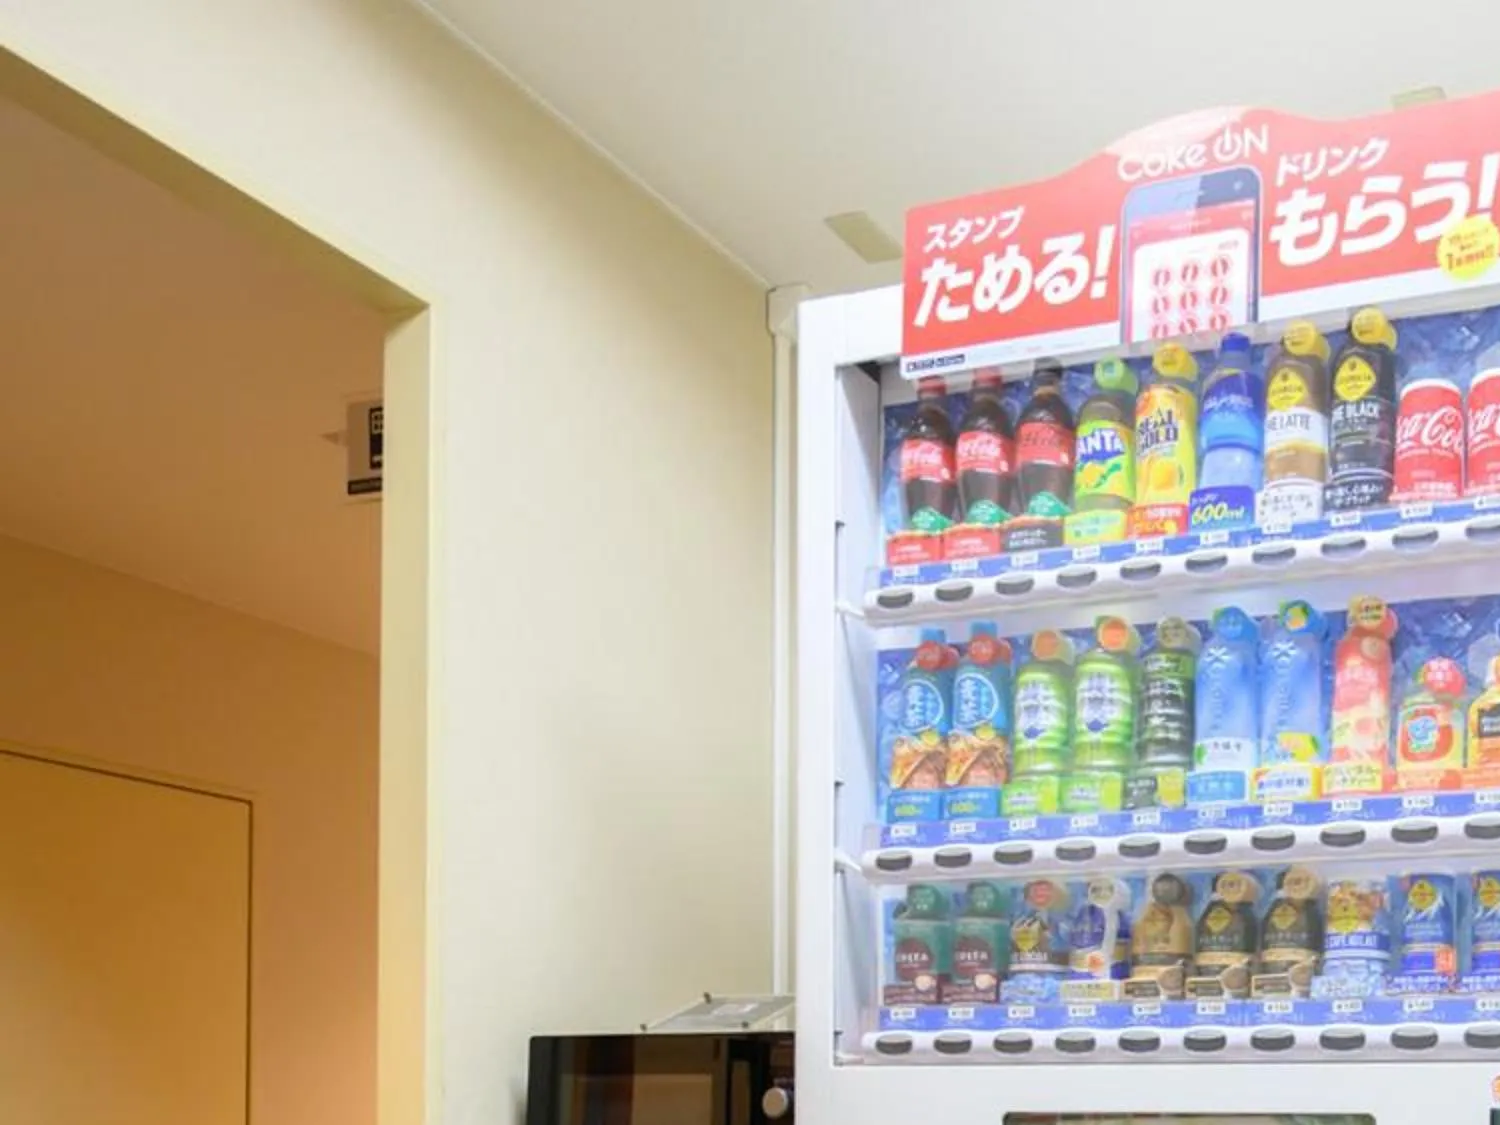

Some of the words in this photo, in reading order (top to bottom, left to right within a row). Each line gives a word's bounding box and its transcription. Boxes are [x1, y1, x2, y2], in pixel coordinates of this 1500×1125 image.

[1276, 138, 1390, 187] ドリンク
[922, 206, 1026, 253] スタンプ
[913, 225, 1116, 328] ためる!
